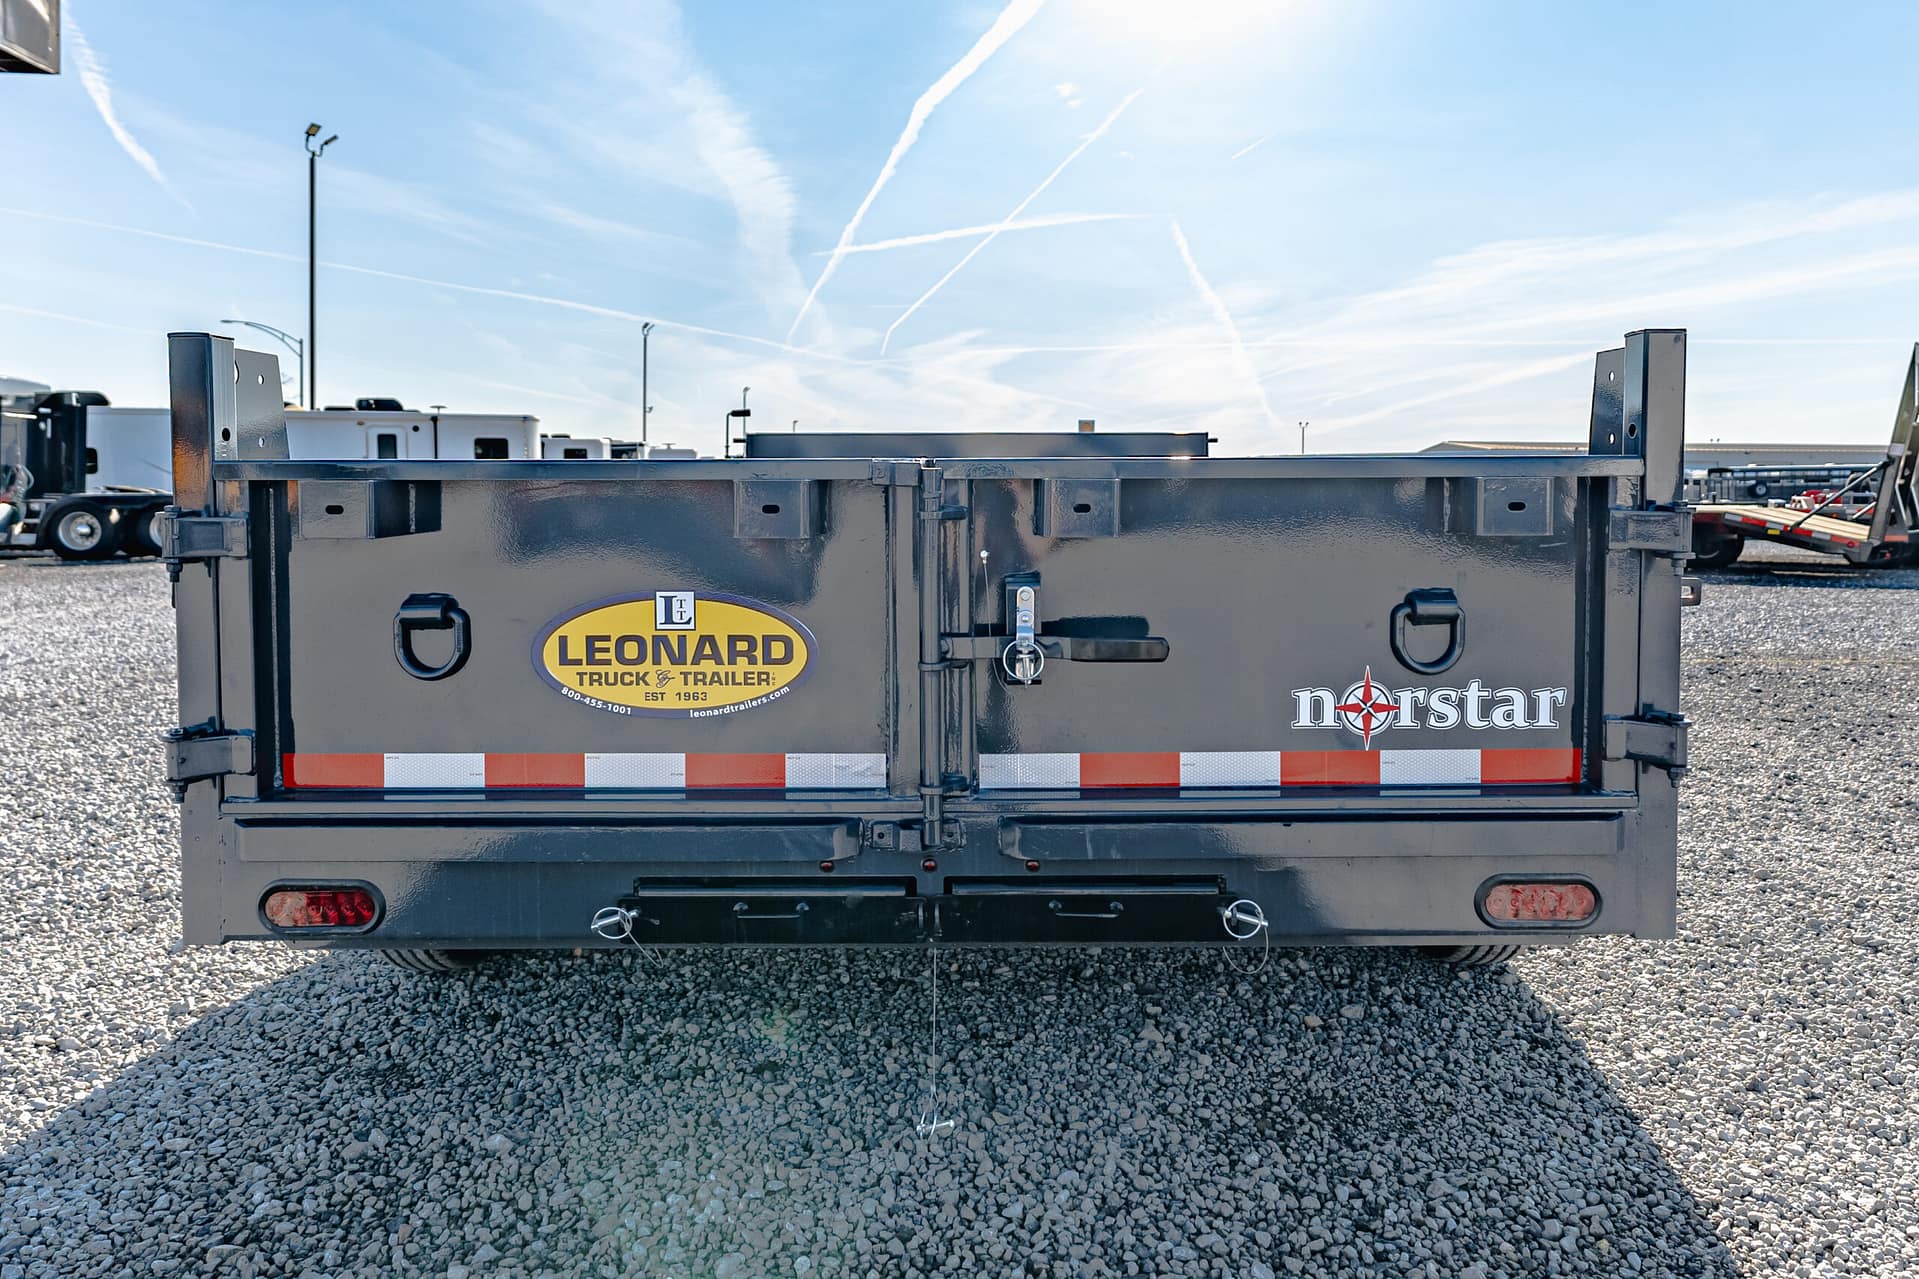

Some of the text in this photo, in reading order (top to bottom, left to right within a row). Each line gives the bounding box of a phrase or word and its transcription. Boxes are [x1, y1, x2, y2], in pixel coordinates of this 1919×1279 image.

[558, 634, 794, 666] LEONARD
[576, 671, 650, 687] TRUCK
[680, 671, 771, 687] TRAILER
[561, 686, 632, 715] 800-455-1001
[644, 691, 708, 702] EST 1963
[689, 685, 790, 718] leonardtrailers.com
